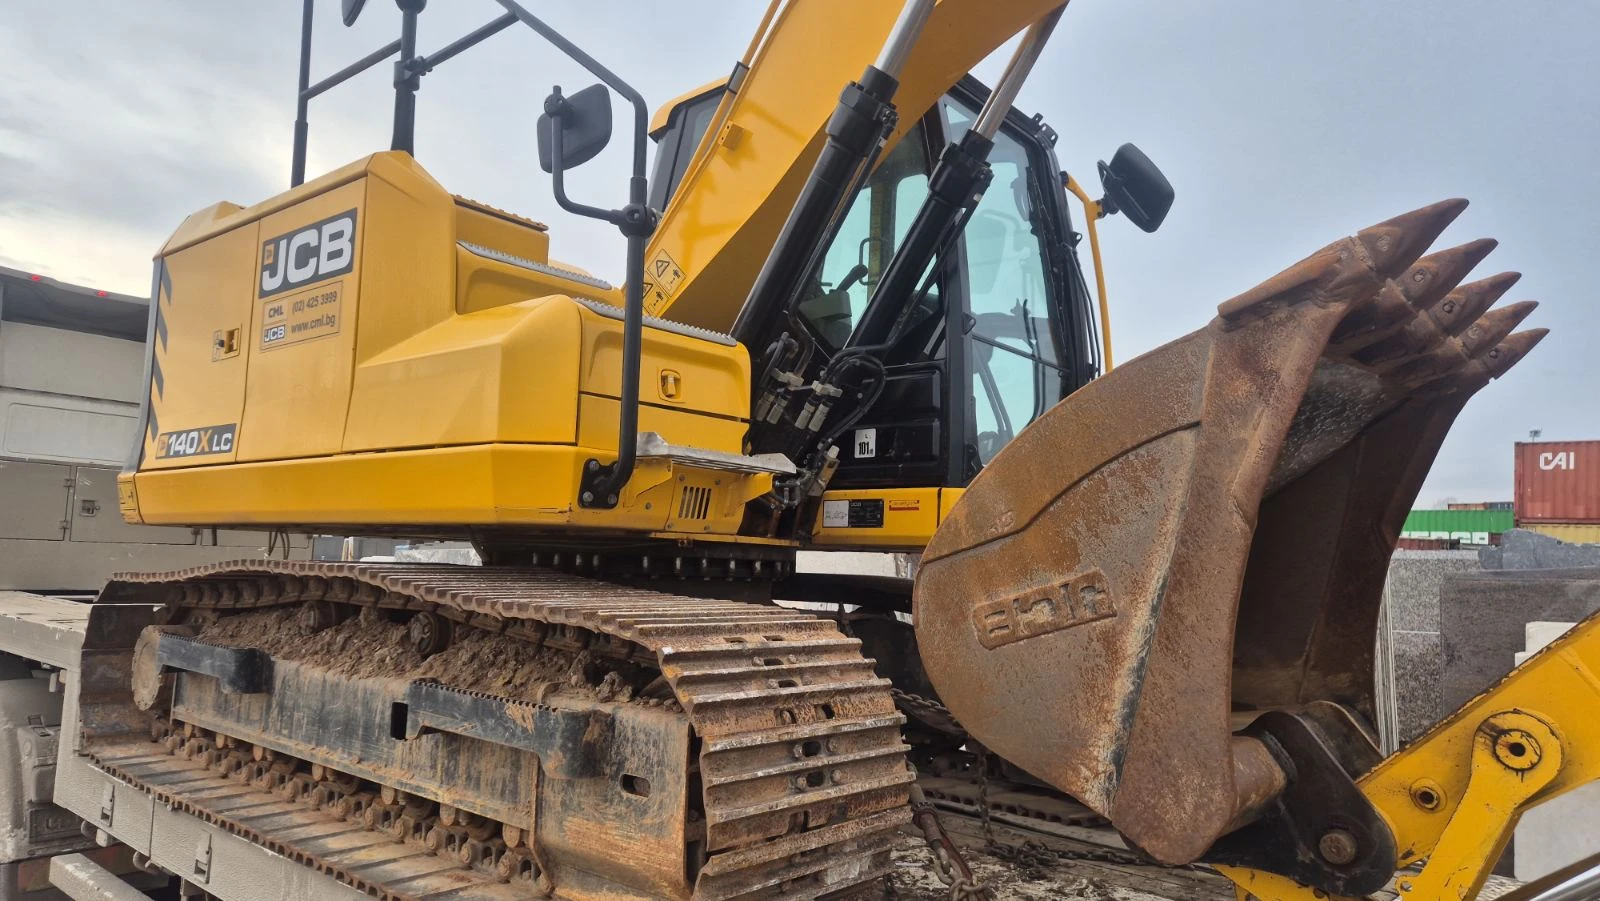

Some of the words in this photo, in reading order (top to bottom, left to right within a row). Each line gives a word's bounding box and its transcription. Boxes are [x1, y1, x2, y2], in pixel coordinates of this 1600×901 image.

[262, 217, 352, 291] JCB
[268, 305, 284, 318] CML
[292, 300, 304, 314] (02)
[306, 295, 319, 308] 425
[291, 314, 335, 333] www.cml.bg
[264, 326, 285, 342] JCB
[212, 433, 232, 451] LC
[858, 441, 869, 455] 101
[1540, 451, 1574, 470] CAI
